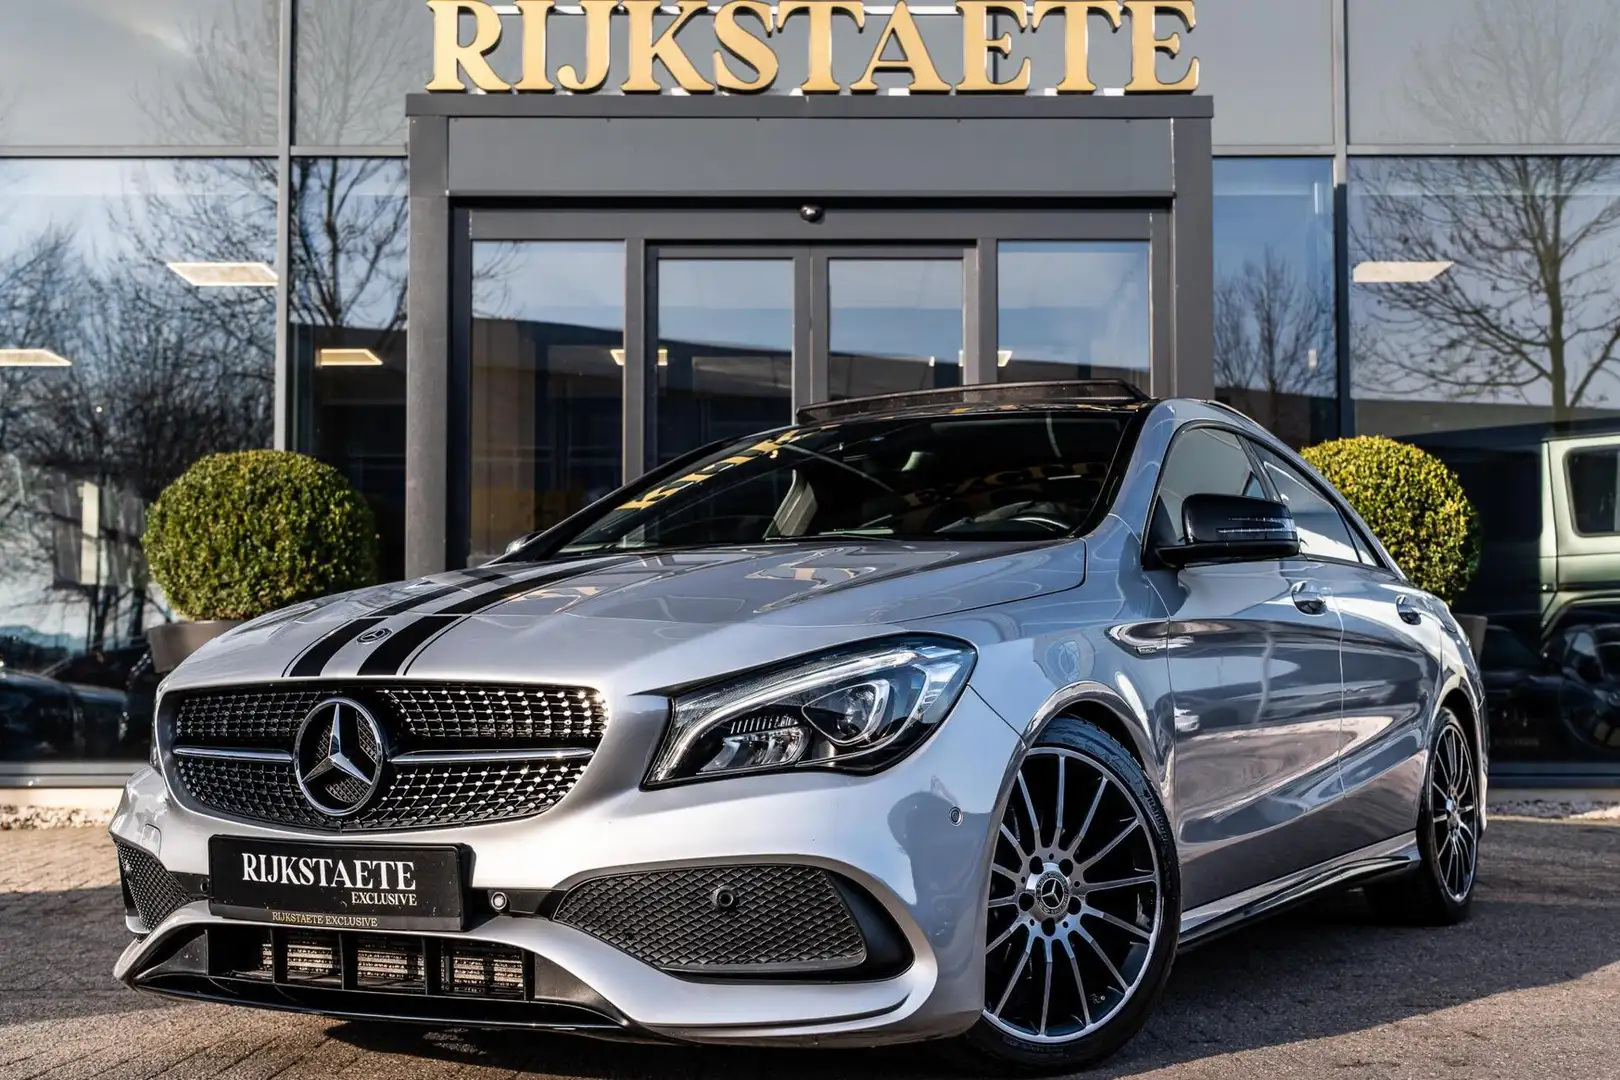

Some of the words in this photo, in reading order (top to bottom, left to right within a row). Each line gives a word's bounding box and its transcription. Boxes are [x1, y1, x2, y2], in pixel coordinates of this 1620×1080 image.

[425, 0, 1200, 94] RIJKSTAETE
[242, 853, 416, 890] RIJKSTAETE
[351, 892, 417, 907] EXCLUSIVE
[272, 911, 324, 925] RIJKSTAETE
[325, 915, 378, 928] EXCLUSIVE
